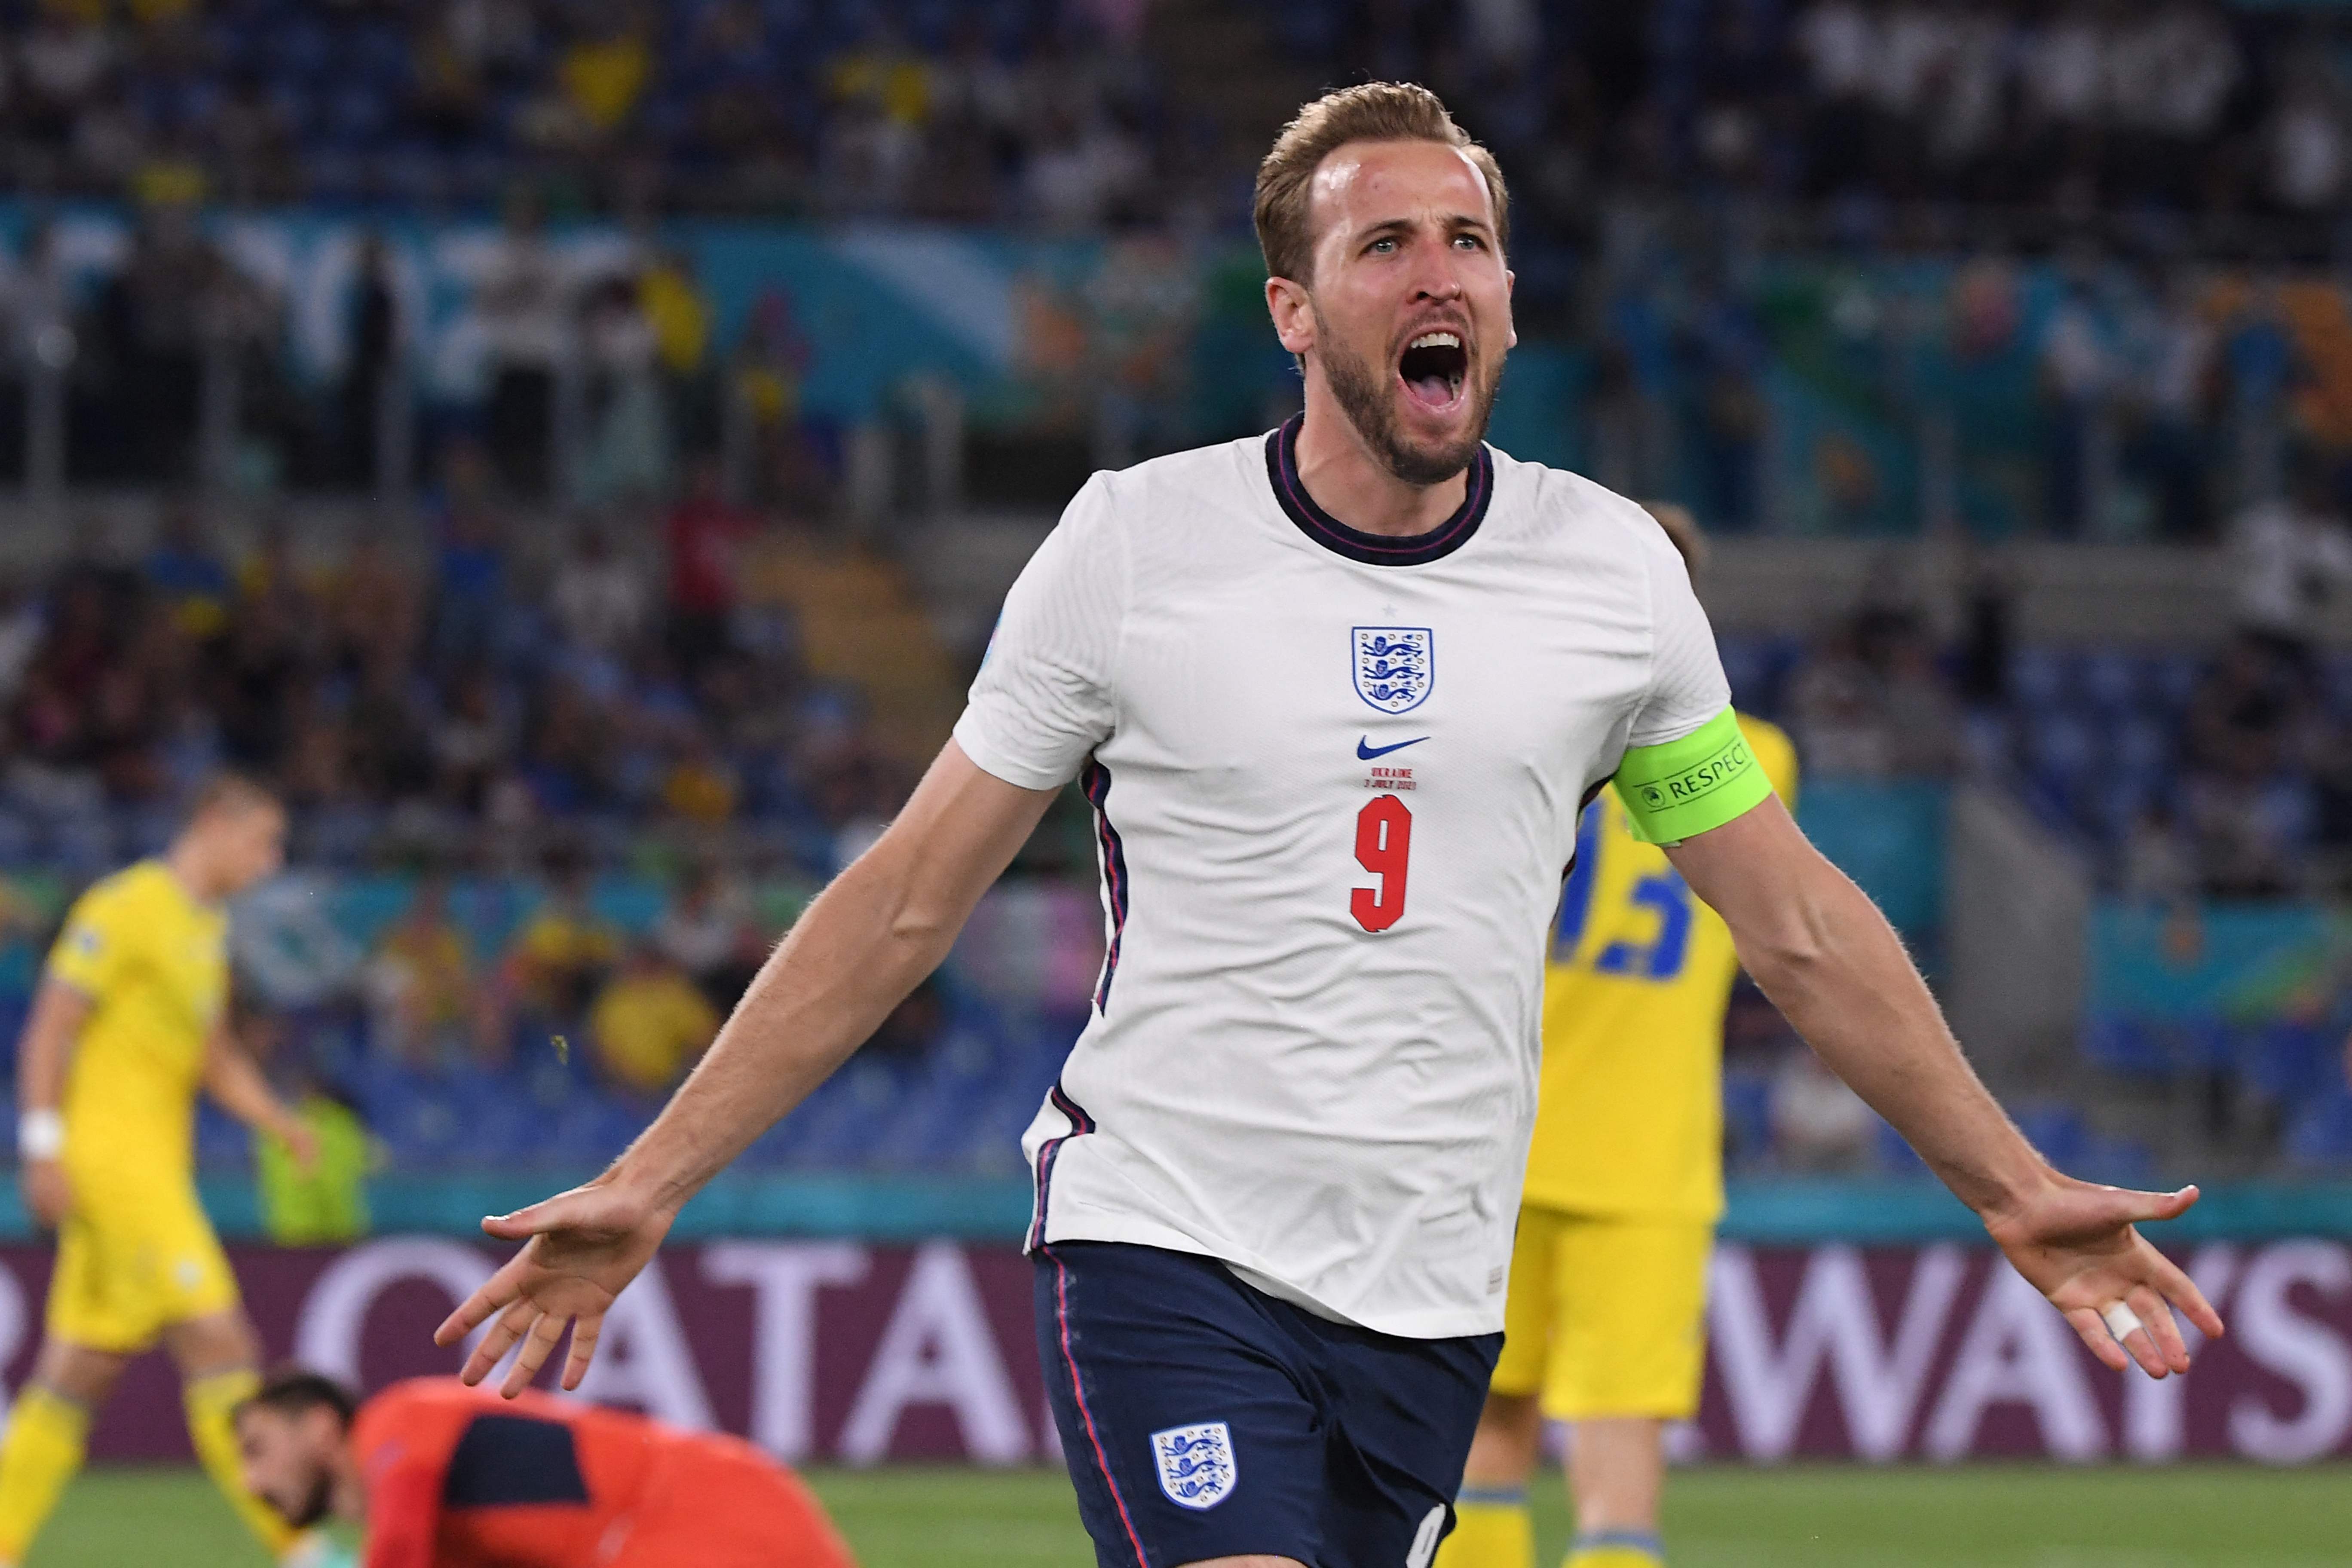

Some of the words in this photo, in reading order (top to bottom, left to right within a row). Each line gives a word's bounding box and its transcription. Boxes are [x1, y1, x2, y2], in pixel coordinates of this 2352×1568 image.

[1669, 742, 1749, 799] RESPECT
[1351, 794, 1412, 933] 9
[294, 1233, 1064, 1468] QATA
